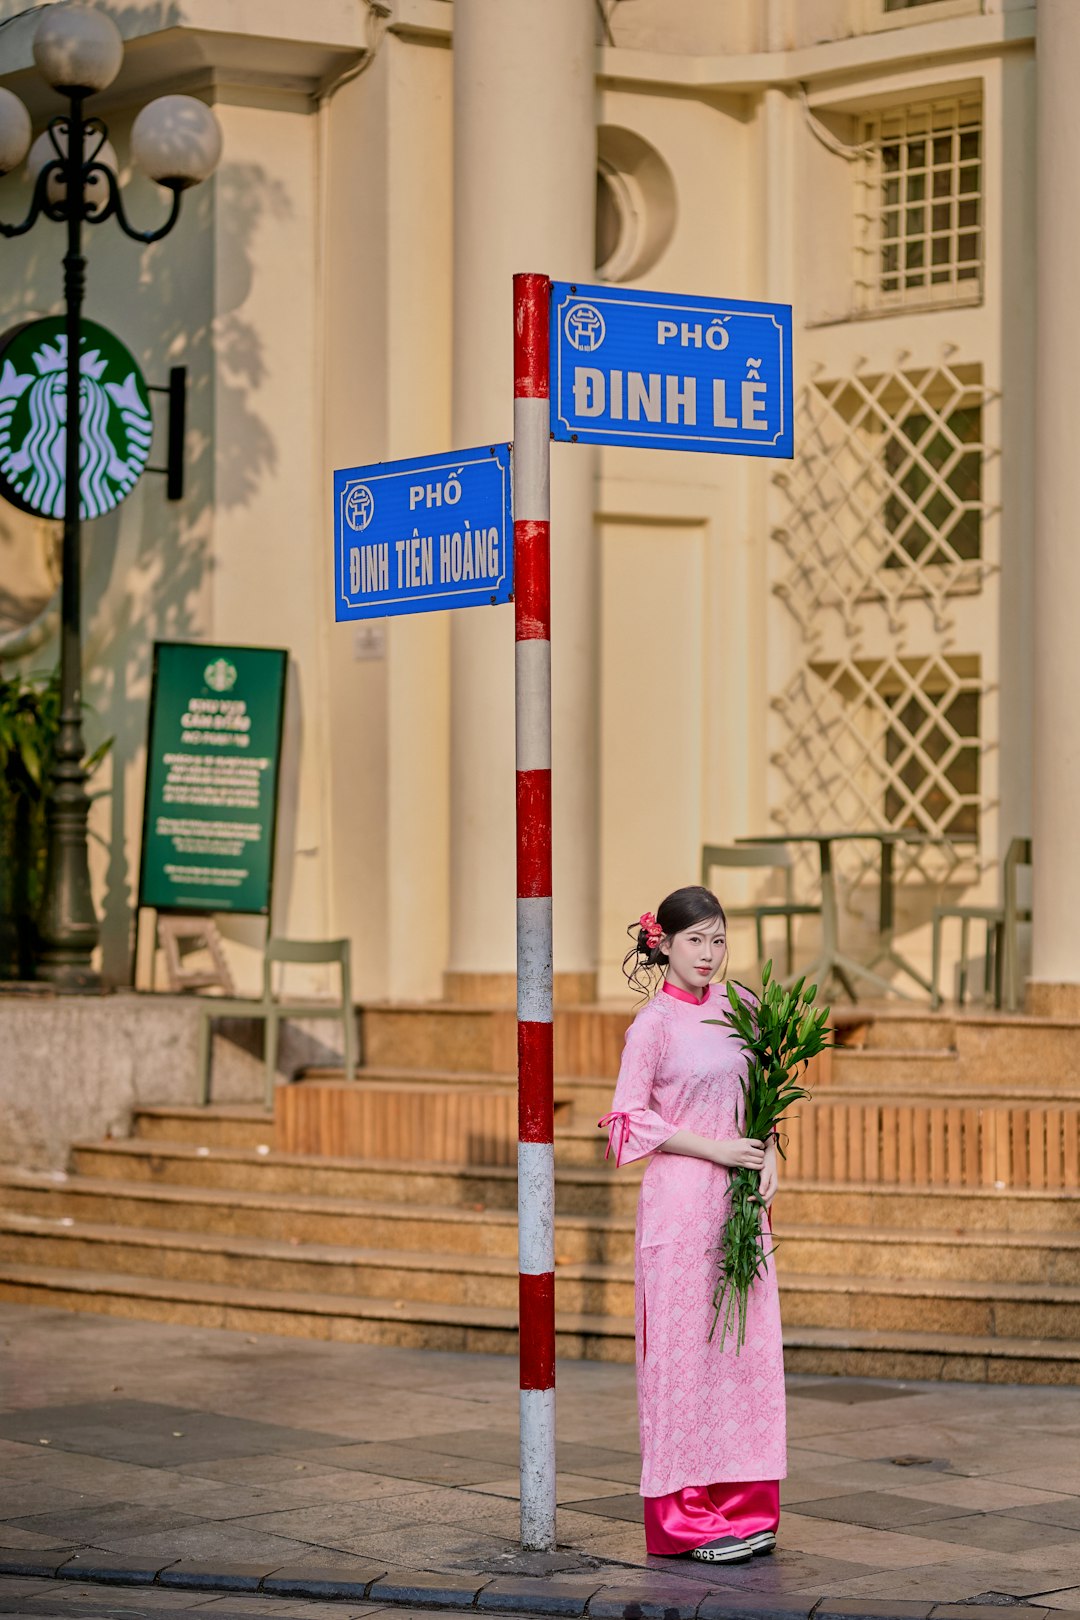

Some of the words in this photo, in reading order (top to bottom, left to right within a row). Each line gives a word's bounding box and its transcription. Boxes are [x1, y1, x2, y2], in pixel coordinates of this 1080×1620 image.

[657, 316, 732, 351] PHỐ
[572, 366, 697, 426] ĐINH
[712, 357, 768, 431] LỄ
[409, 467, 464, 511] PHỐ
[350, 542, 389, 594] ĐINH
[395, 528, 433, 589] TIÊN
[440, 520, 499, 584] HOÀNG
